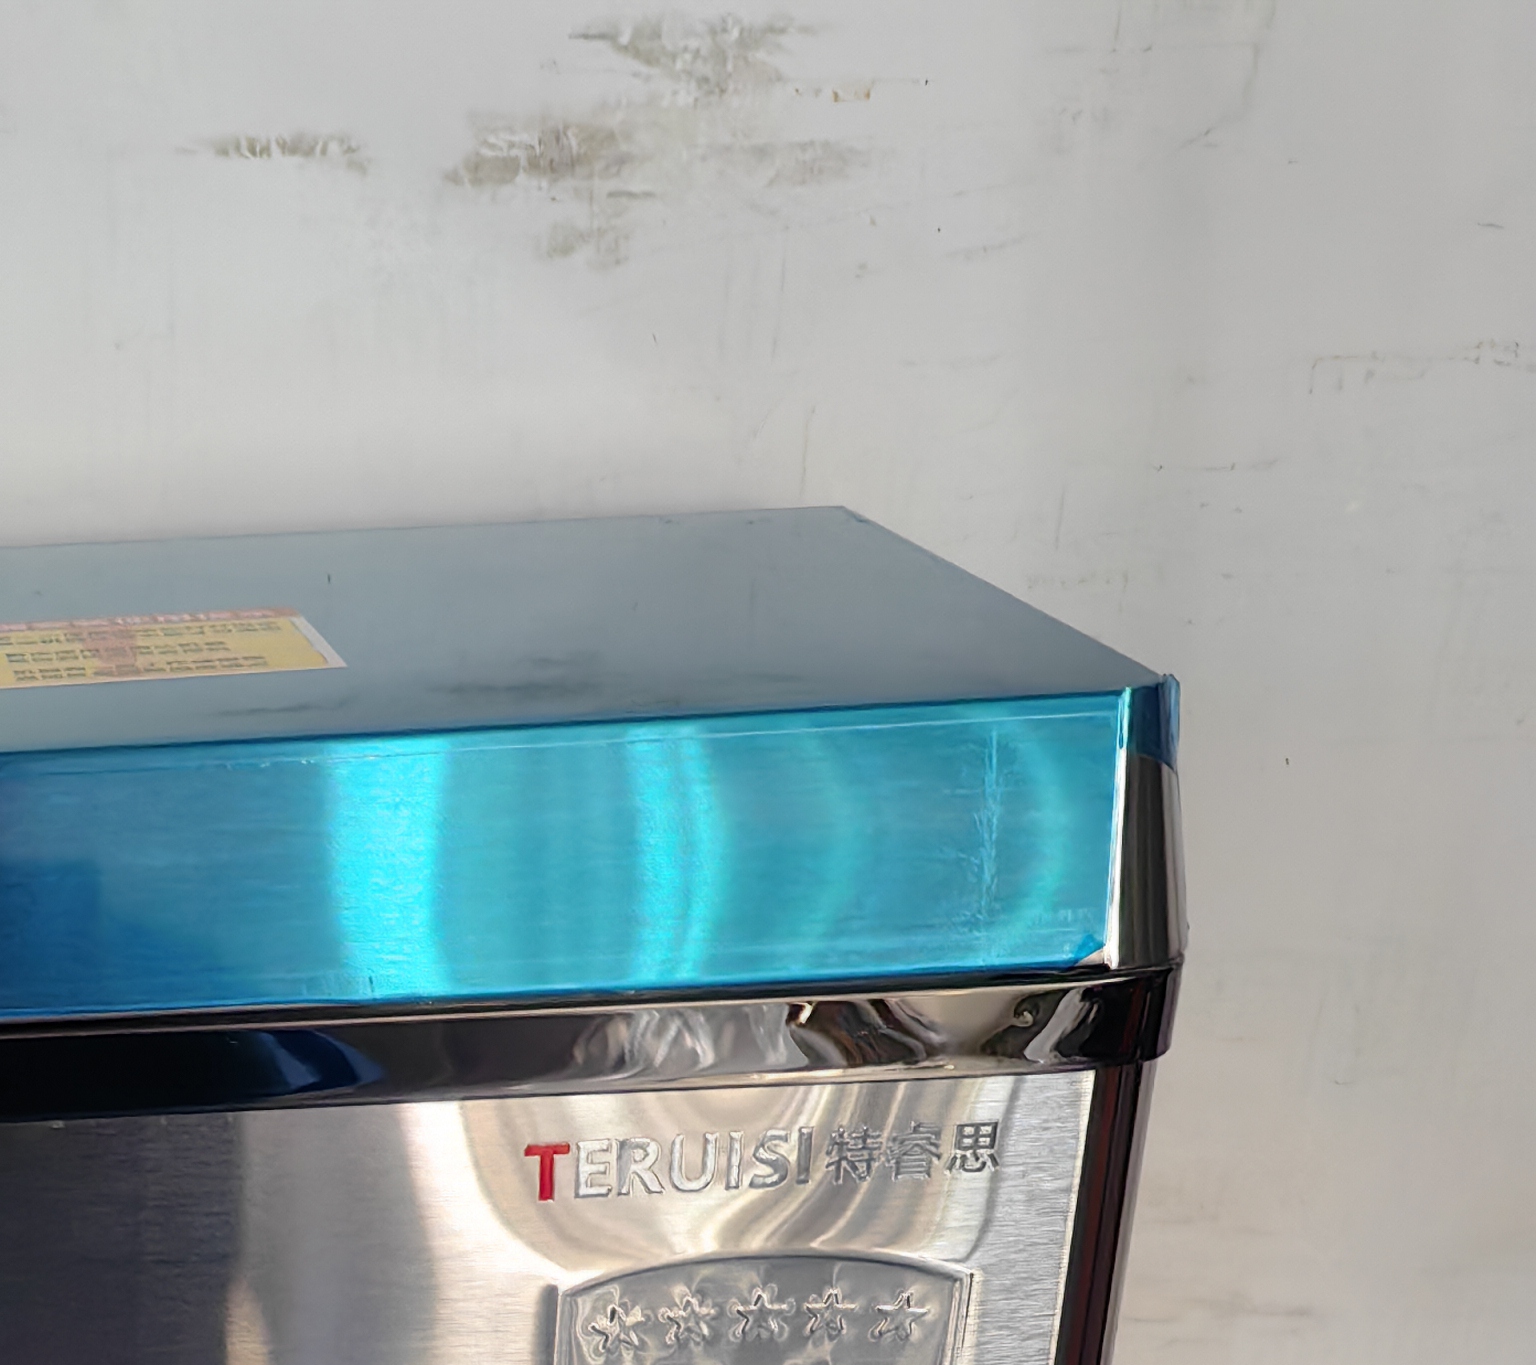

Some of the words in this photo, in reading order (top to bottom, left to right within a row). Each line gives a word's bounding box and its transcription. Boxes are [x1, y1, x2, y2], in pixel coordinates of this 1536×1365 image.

[524, 1125, 813, 1201] TERUISI
[824, 1119, 1001, 1183] 特睿思
